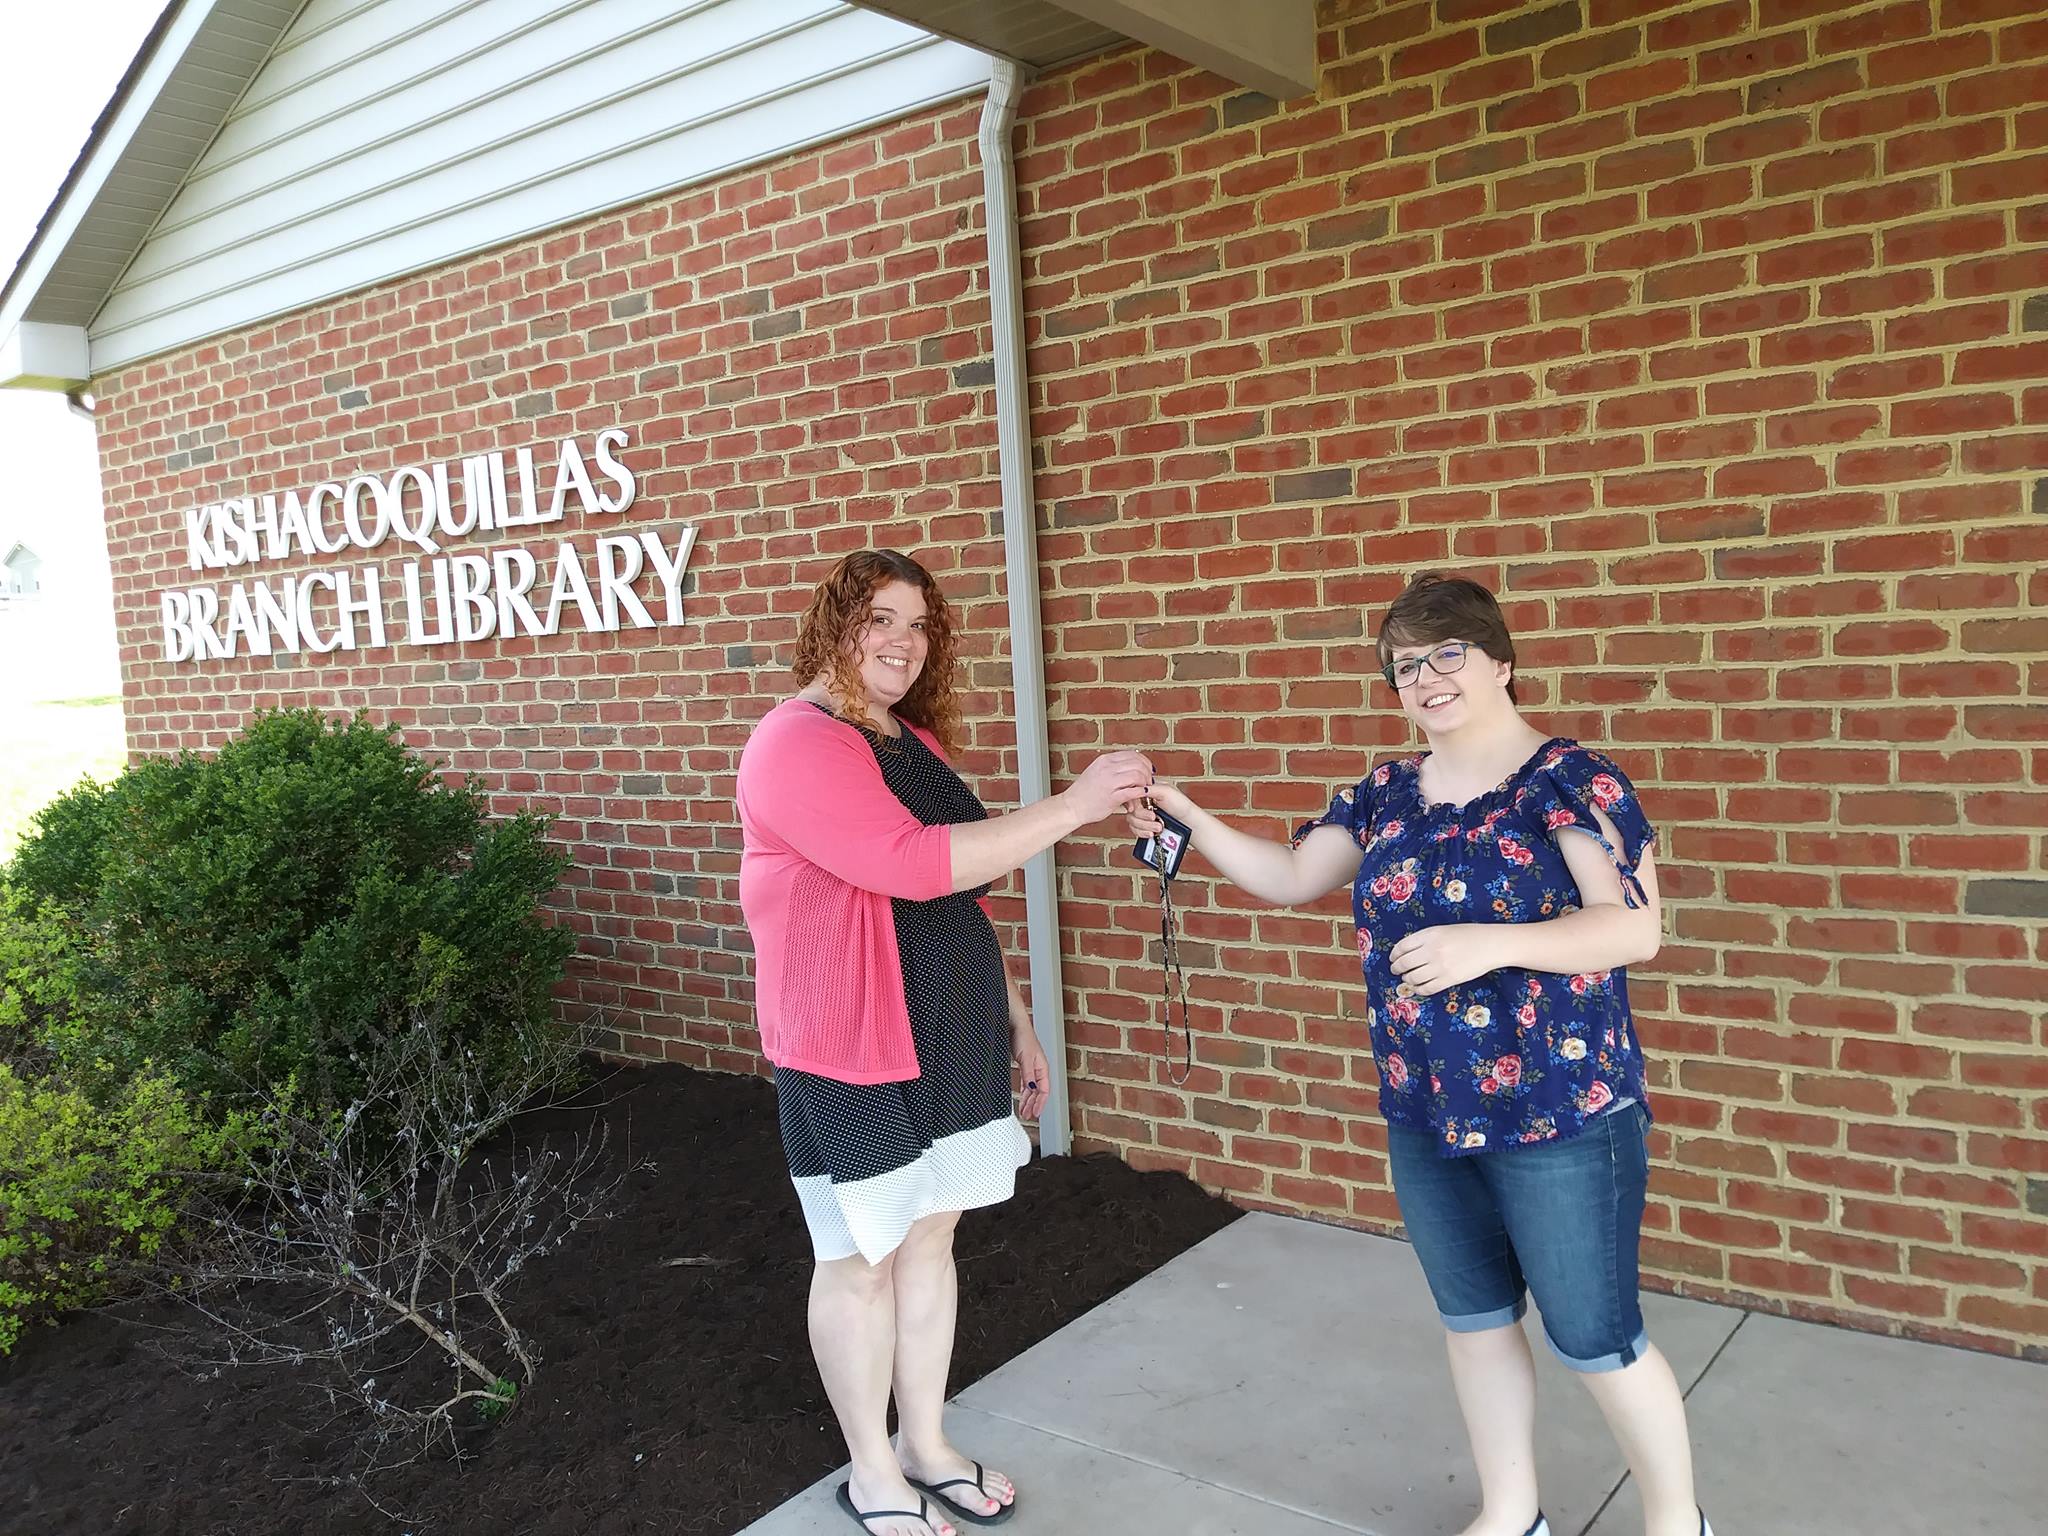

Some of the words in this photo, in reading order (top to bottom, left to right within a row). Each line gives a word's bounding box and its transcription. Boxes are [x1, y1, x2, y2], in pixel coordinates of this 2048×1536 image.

[185, 429, 635, 571] KISHACOQUILLAS
[161, 567, 387, 663] BRANCH
[404, 526, 699, 647] LIBRARY
